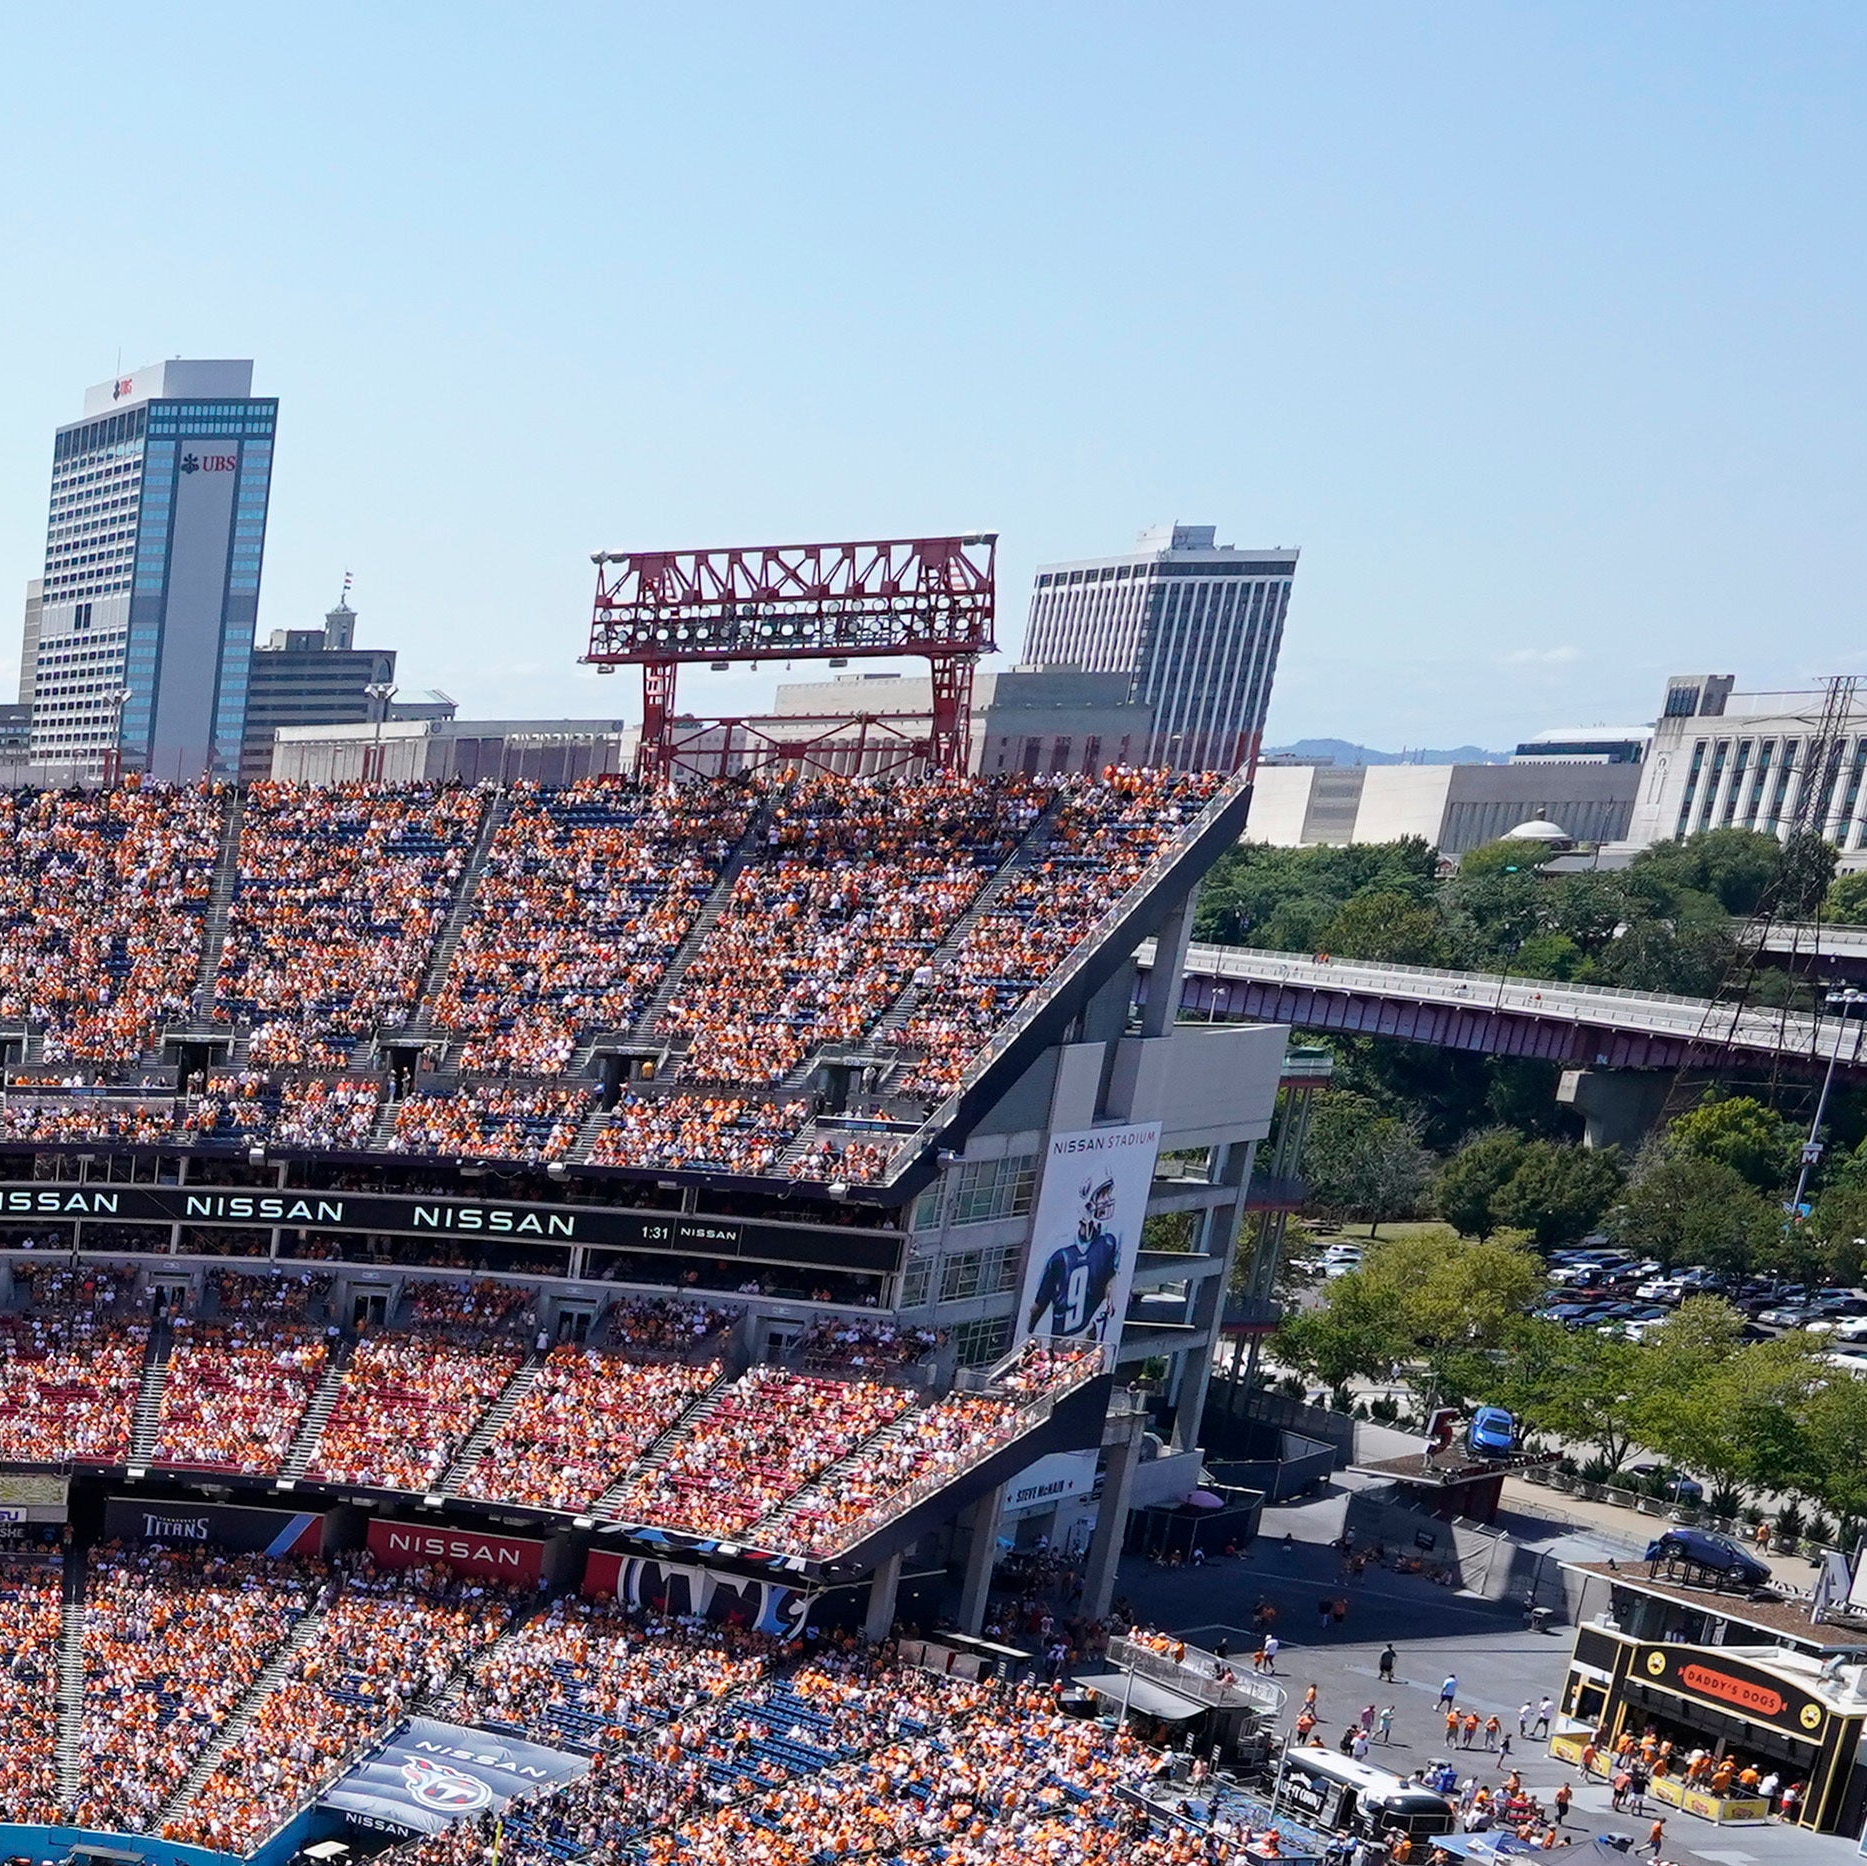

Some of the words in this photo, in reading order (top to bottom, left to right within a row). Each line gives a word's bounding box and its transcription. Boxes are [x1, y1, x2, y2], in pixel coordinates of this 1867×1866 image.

[202, 455, 237, 473] UBS
[1053, 1137, 1104, 1156] NISSAN
[1107, 1130, 1156, 1150] STADIUM
[1802, 1151, 1819, 1164] M
[186, 1196, 343, 1221] NISSAN
[413, 1206, 575, 1235] NISSAN
[642, 1226, 669, 1241] 1:31
[679, 1227, 737, 1241] NISSAN
[1064, 1265, 1089, 1333] 9
[142, 1512, 209, 1540] TITANS
[388, 1532, 521, 1567] NISSAN
[1688, 1670, 1738, 1698] DADDY'S
[1741, 1686, 1778, 1710] DOGS
[415, 1739, 547, 1779] NISSAN
[344, 1811, 409, 1838] NISSAN
